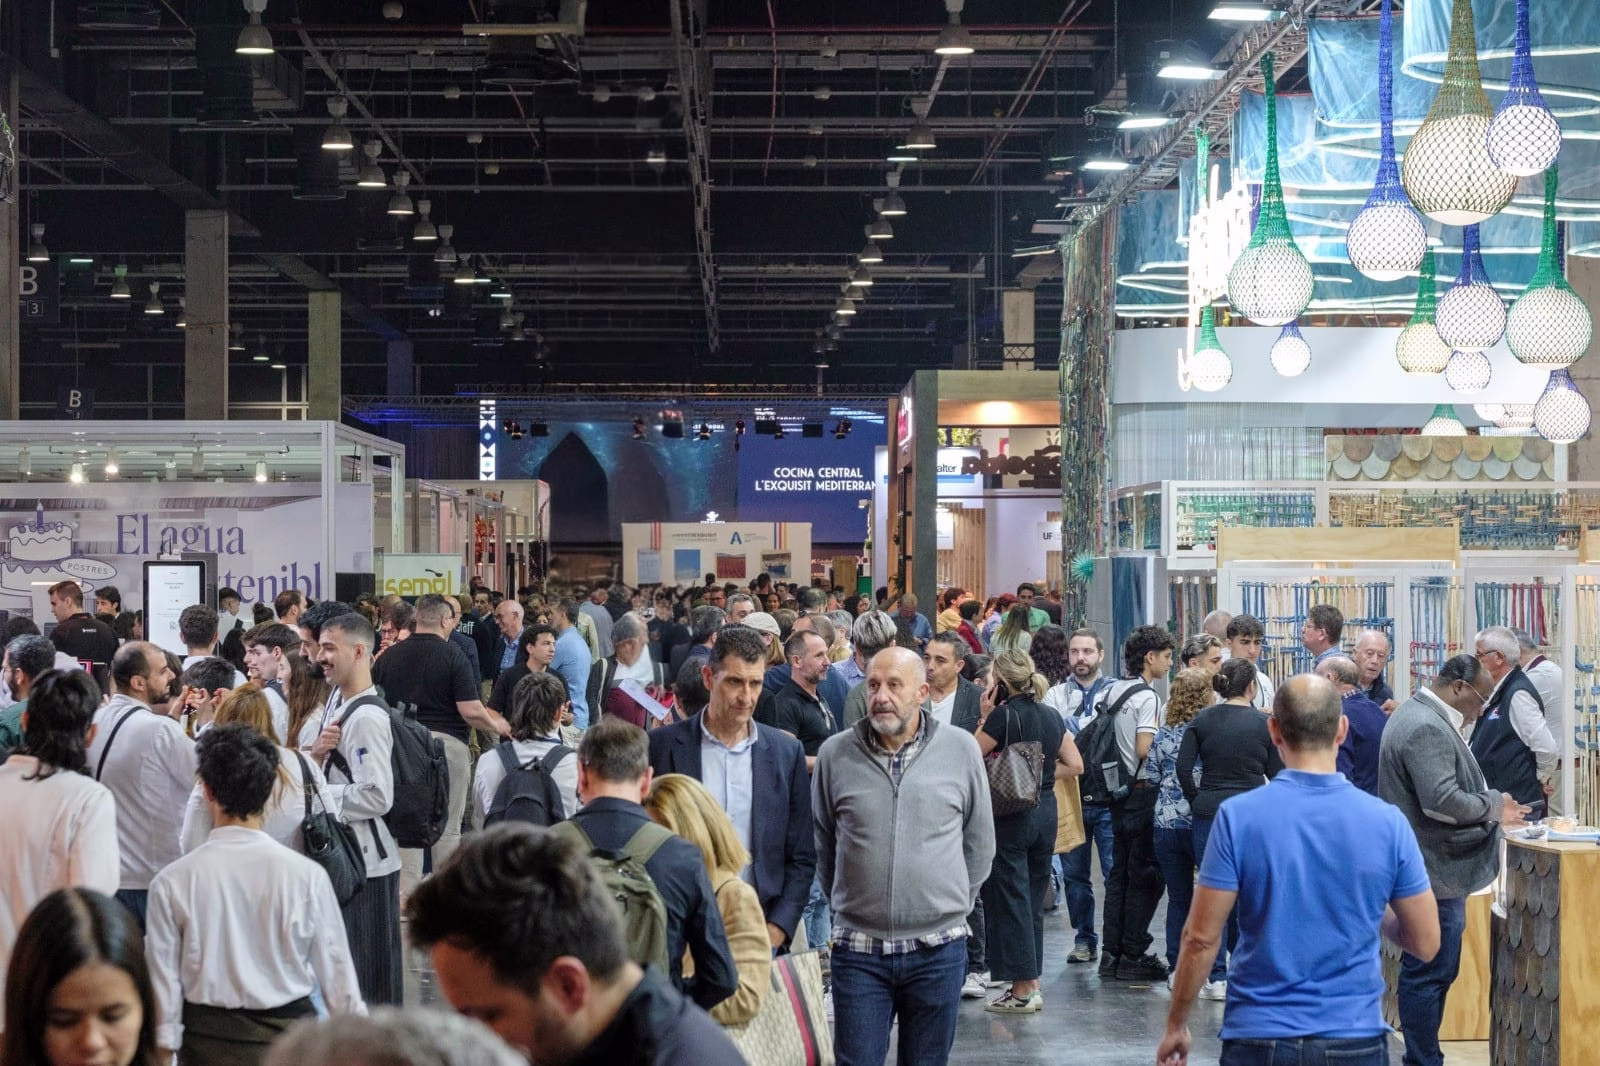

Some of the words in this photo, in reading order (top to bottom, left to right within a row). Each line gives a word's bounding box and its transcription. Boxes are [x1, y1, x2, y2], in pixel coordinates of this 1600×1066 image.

[19, 266, 38, 295] B
[31, 303, 39, 314] 3
[69, 389, 82, 408] B
[774, 467, 815, 478] COCINA
[818, 467, 863, 478] CENTRAL
[755, 480, 812, 491] L'EXQUISIT
[116, 513, 150, 556] El
[159, 523, 246, 555] agua
[67, 562, 108, 575] POSTRES
[218, 561, 322, 604] tenibl
